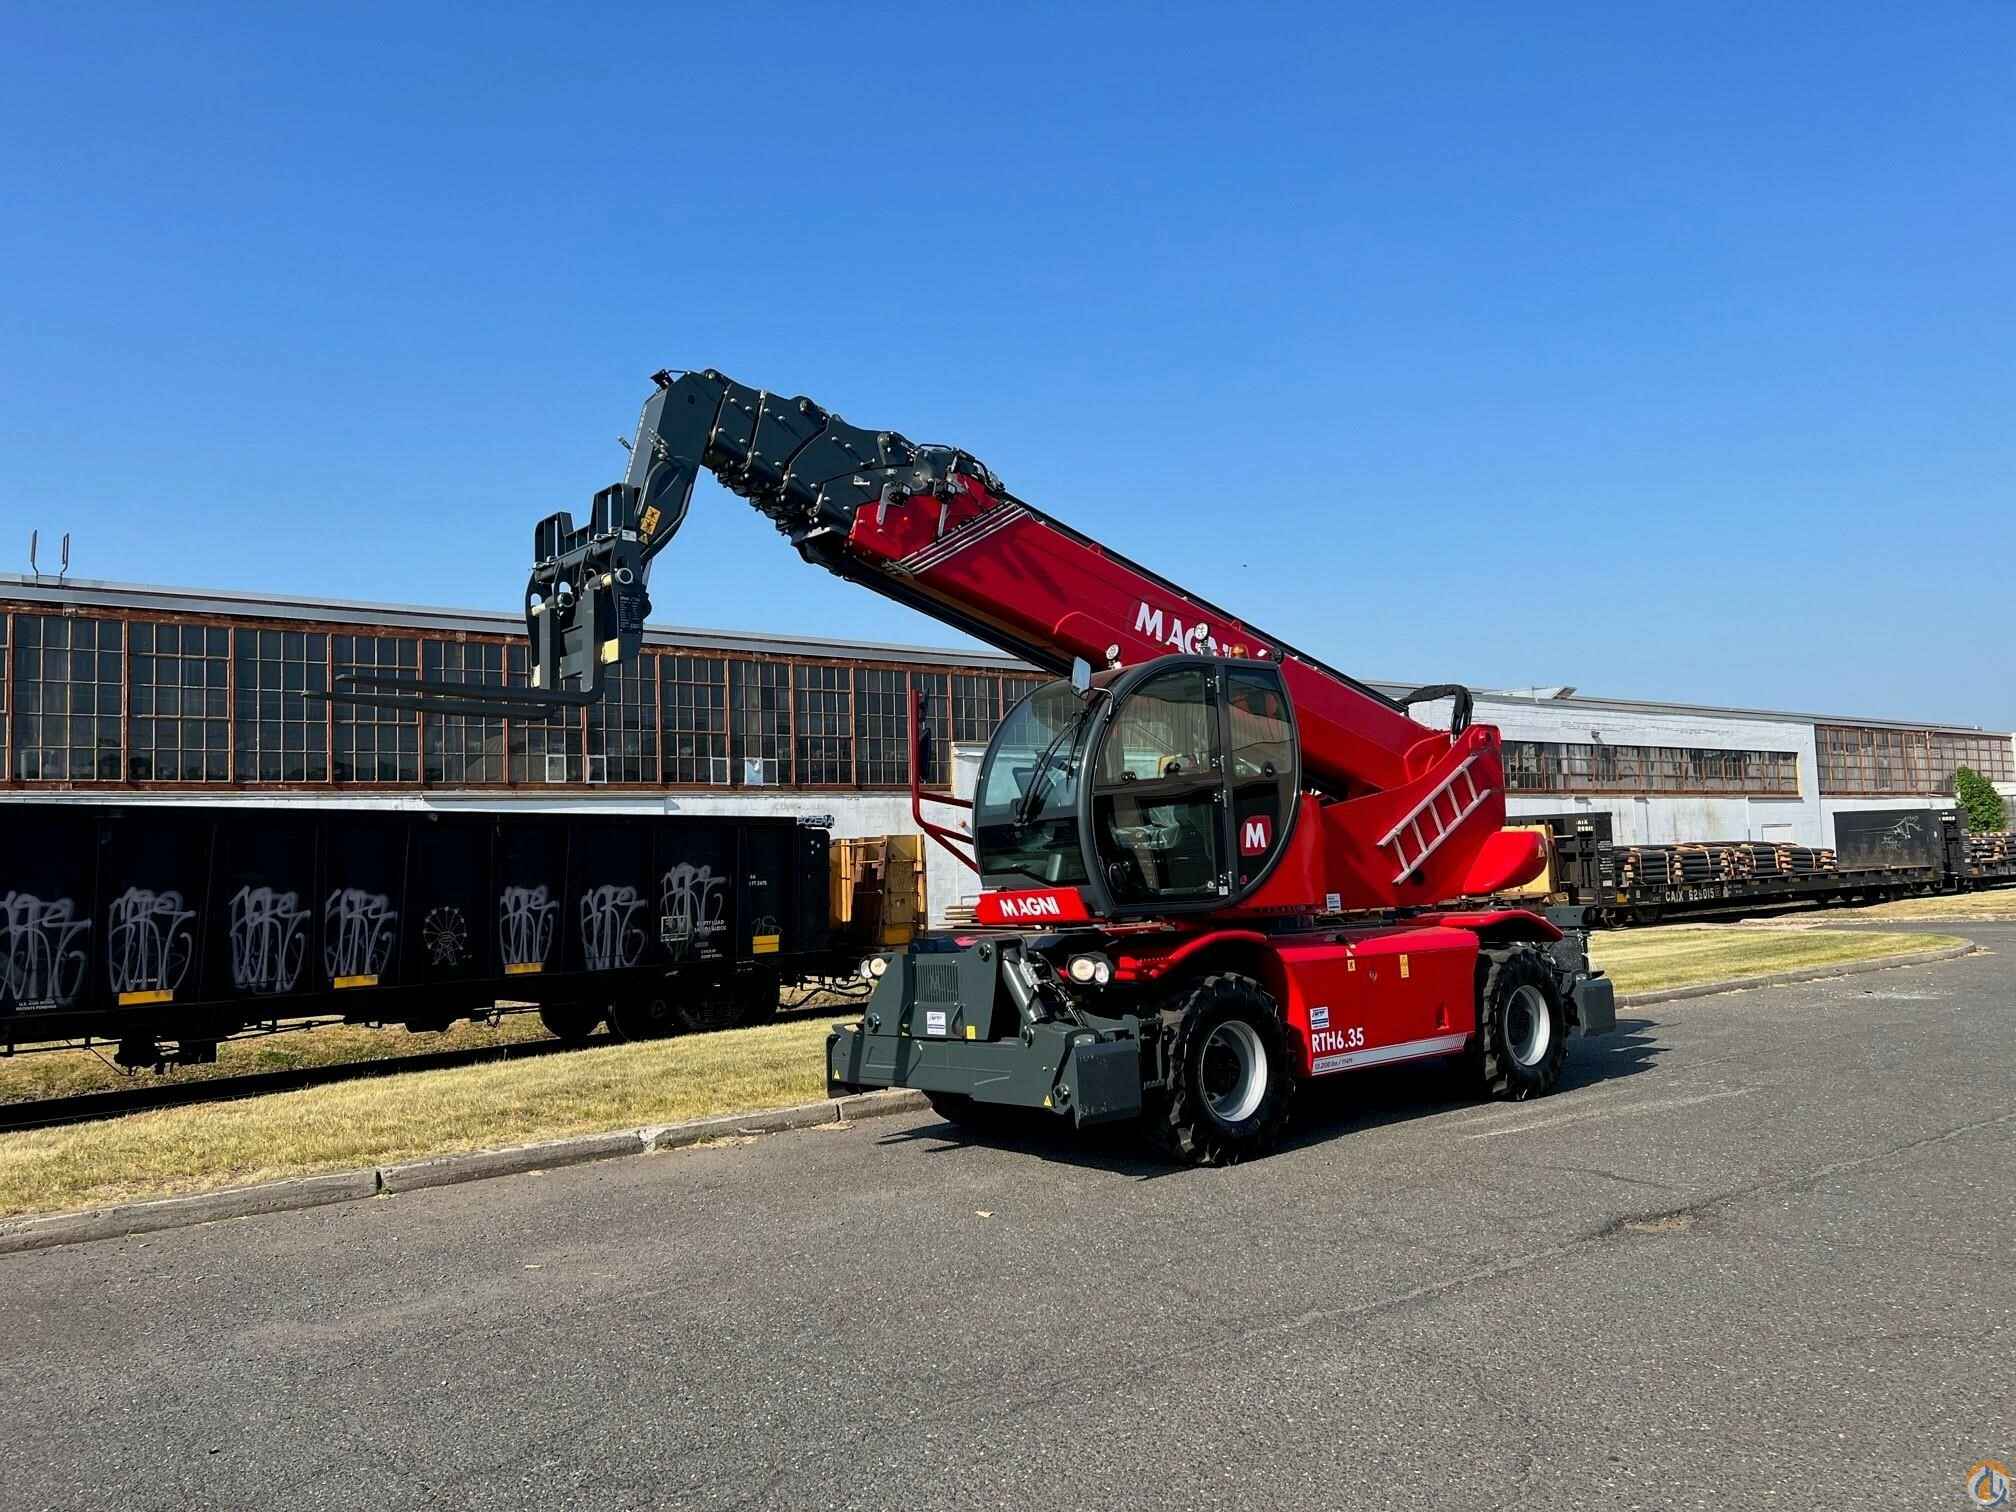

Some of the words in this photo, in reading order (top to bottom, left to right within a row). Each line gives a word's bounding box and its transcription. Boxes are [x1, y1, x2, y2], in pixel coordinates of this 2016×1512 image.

[1245, 822, 1267, 849] M
[999, 895, 1060, 917] MAGNI
[1665, 890, 1684, 903] CAIX
[1311, 1026, 1365, 1054] RTH6.35
